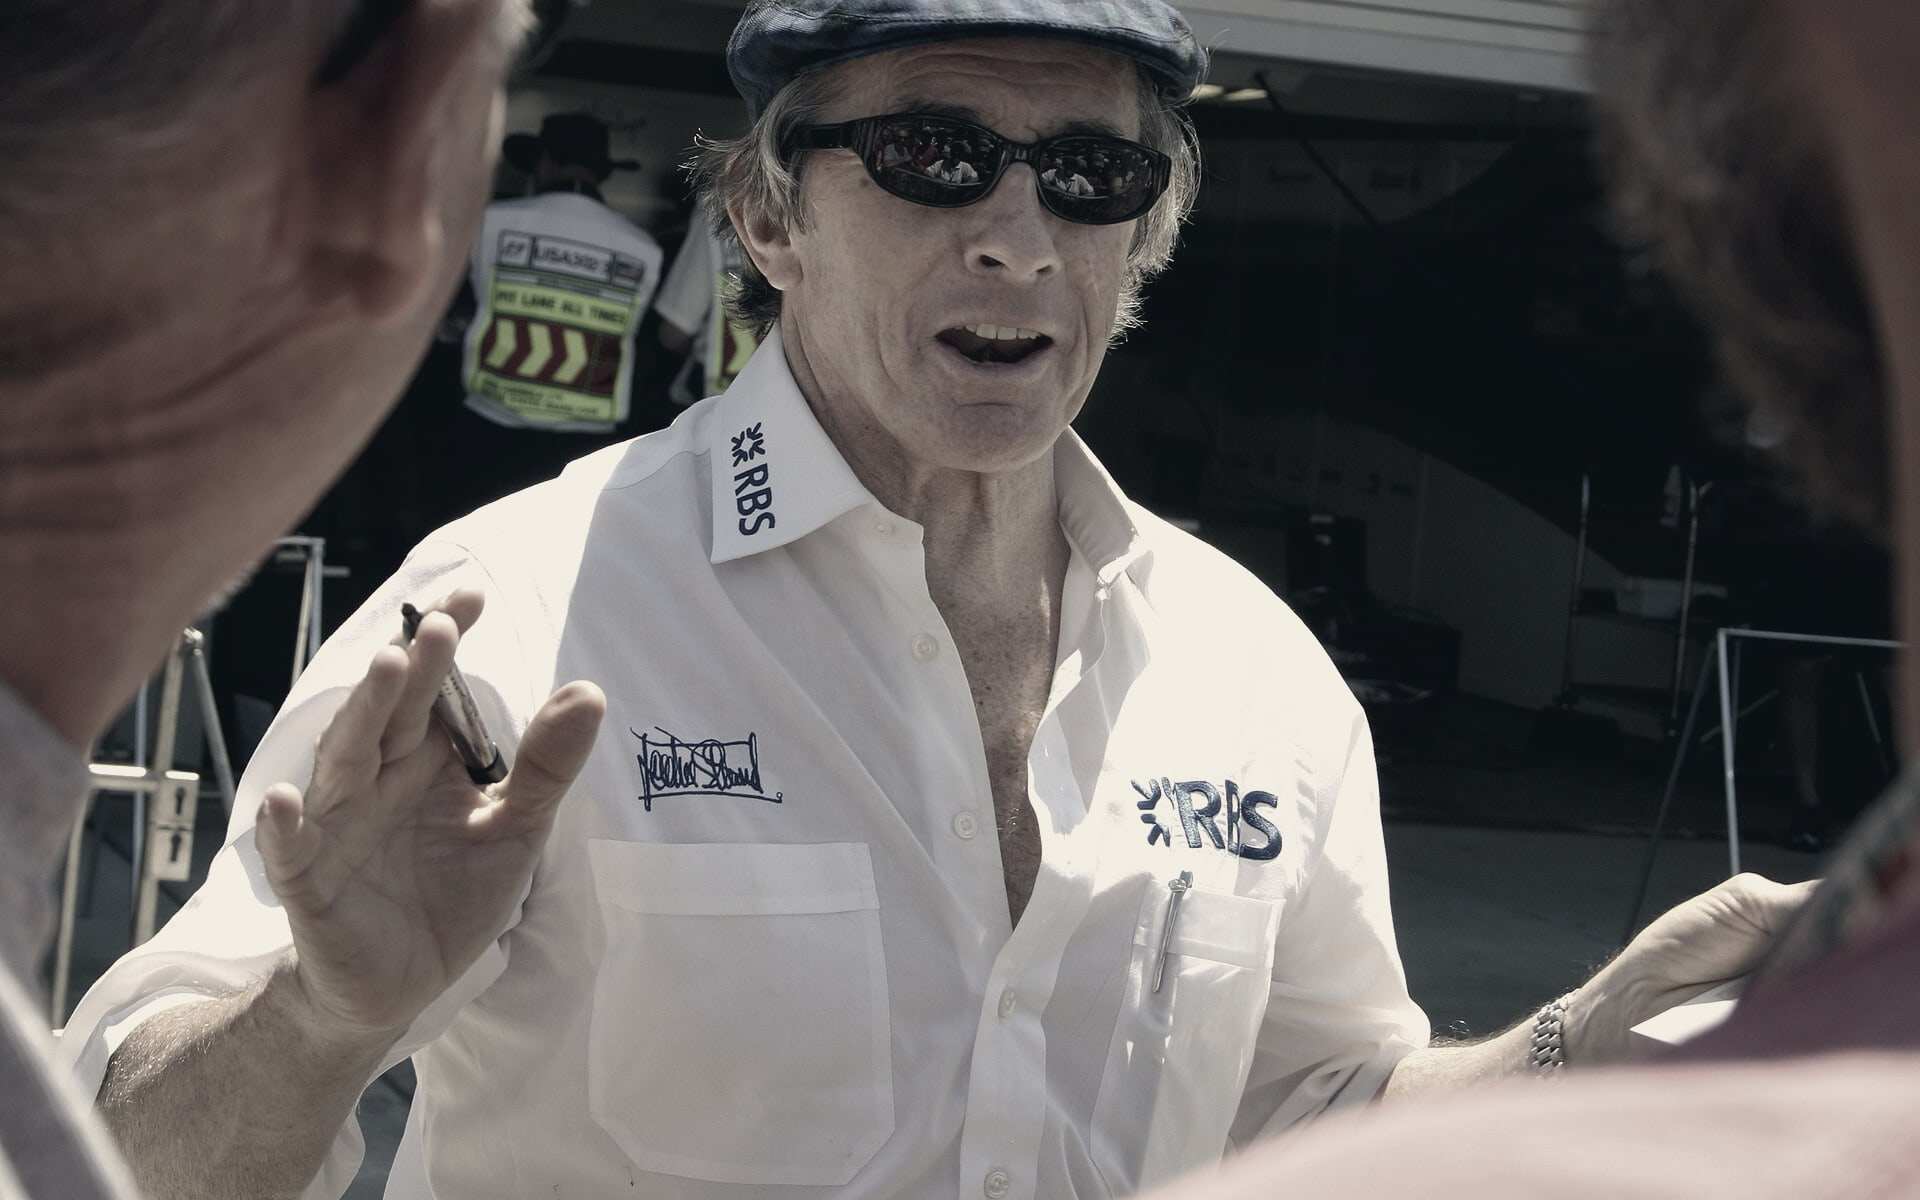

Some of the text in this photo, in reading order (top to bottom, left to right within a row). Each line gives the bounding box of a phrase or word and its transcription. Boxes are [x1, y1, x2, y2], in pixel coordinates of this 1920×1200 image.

[521, 294, 555, 309] LANE
[561, 301, 583, 316] ALL
[734, 463, 775, 536] RBS
[1173, 779, 1283, 861] RBS
